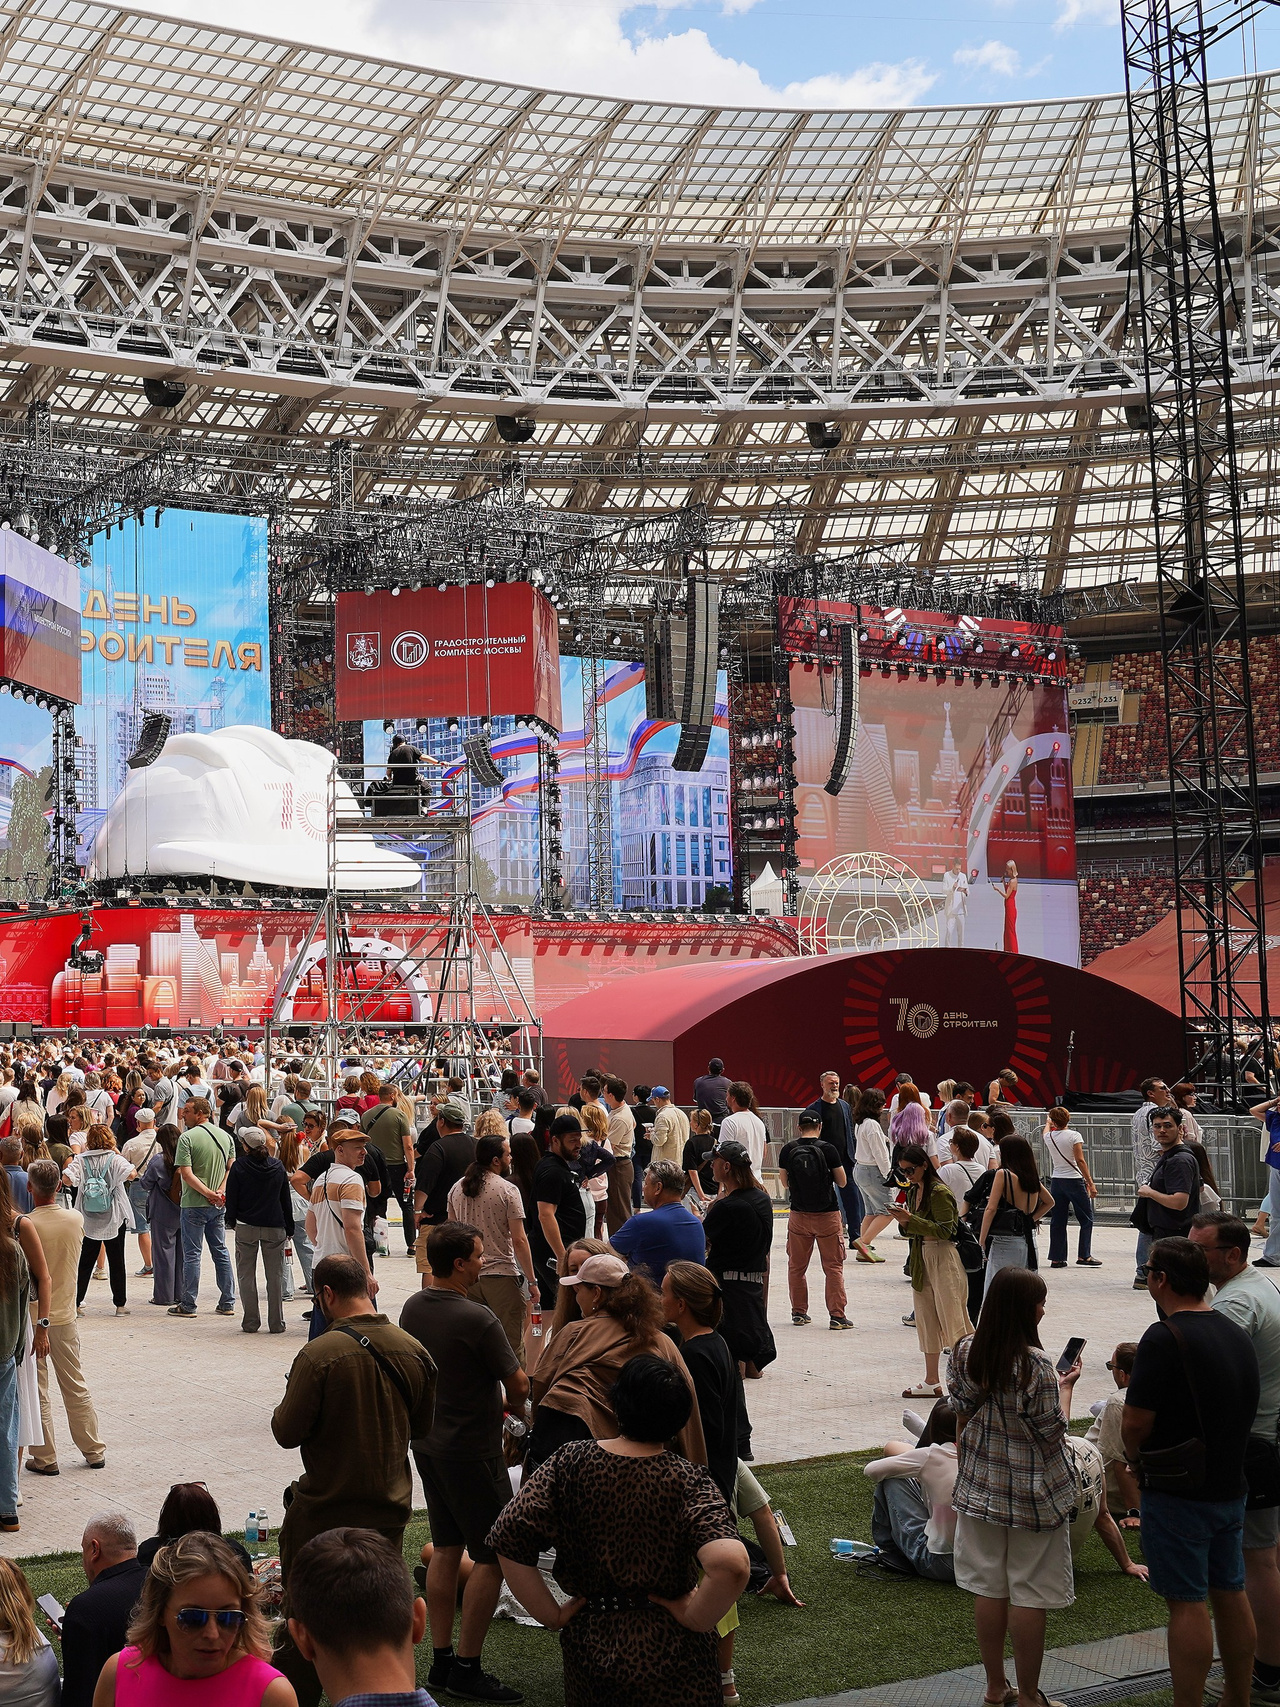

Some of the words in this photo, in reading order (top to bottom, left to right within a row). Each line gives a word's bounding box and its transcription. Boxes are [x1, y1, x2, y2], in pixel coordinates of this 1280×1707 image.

[82, 589, 196, 626] ДЕНЬ
[434, 634, 527, 648] ГРАДОСТРОИТЕЛЬНЫЙ
[81, 629, 262, 671] РОИТЕЛЯ
[434, 648, 481, 657] КОМПЛЕКС
[484, 646, 522, 656] МОСКВЫ
[943, 1020, 998, 1028] СТРОИТЕЛЯ
